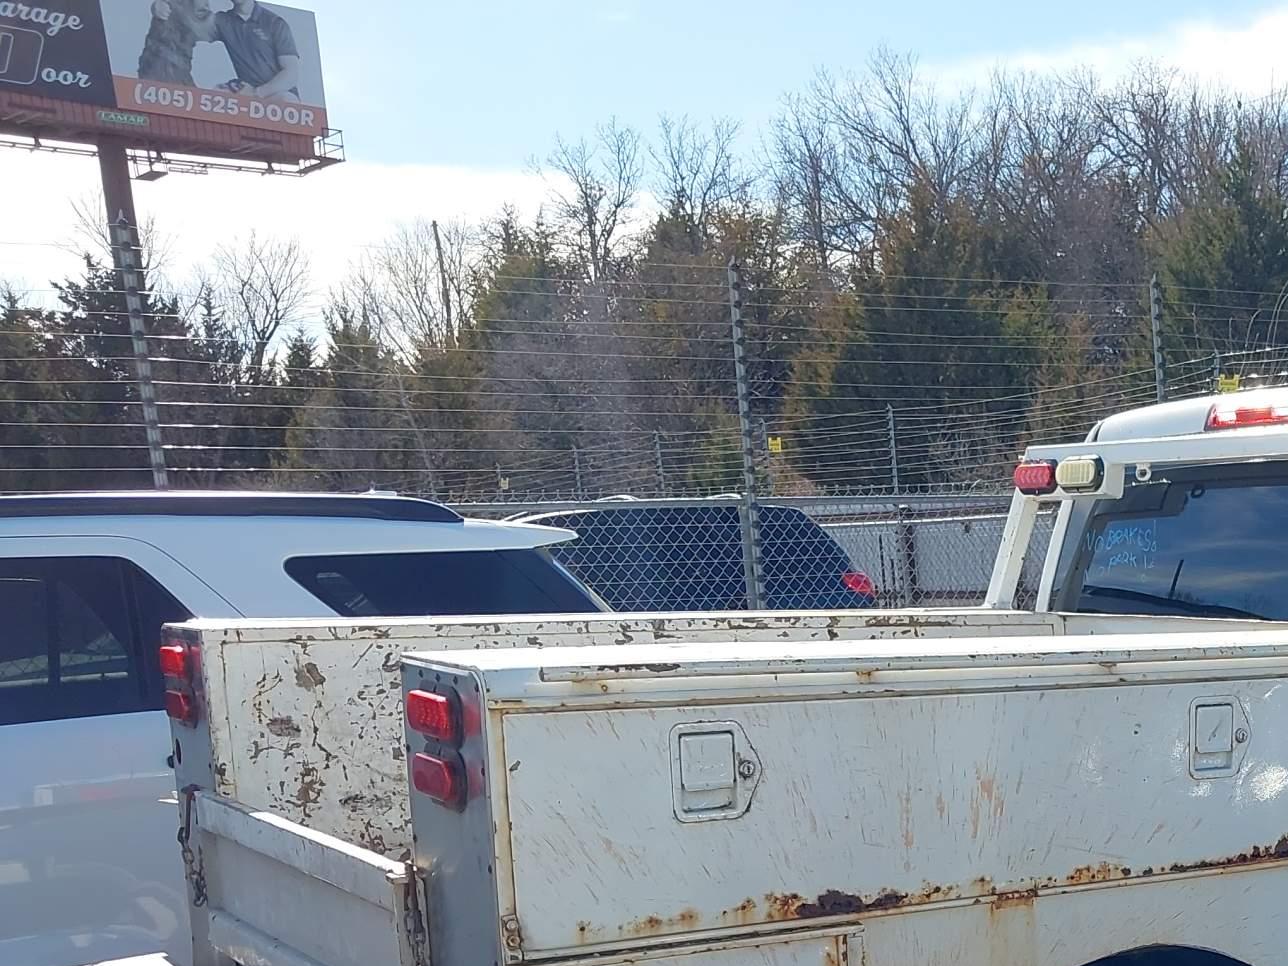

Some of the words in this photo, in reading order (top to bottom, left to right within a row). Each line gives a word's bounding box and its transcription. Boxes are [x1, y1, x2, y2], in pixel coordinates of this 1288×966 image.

[0, 1, 84, 37] arage
[100, 111, 146, 125] LAMAR
[134, 83, 194, 112] (405)
[200, 94, 315, 128] 525-DOOR
